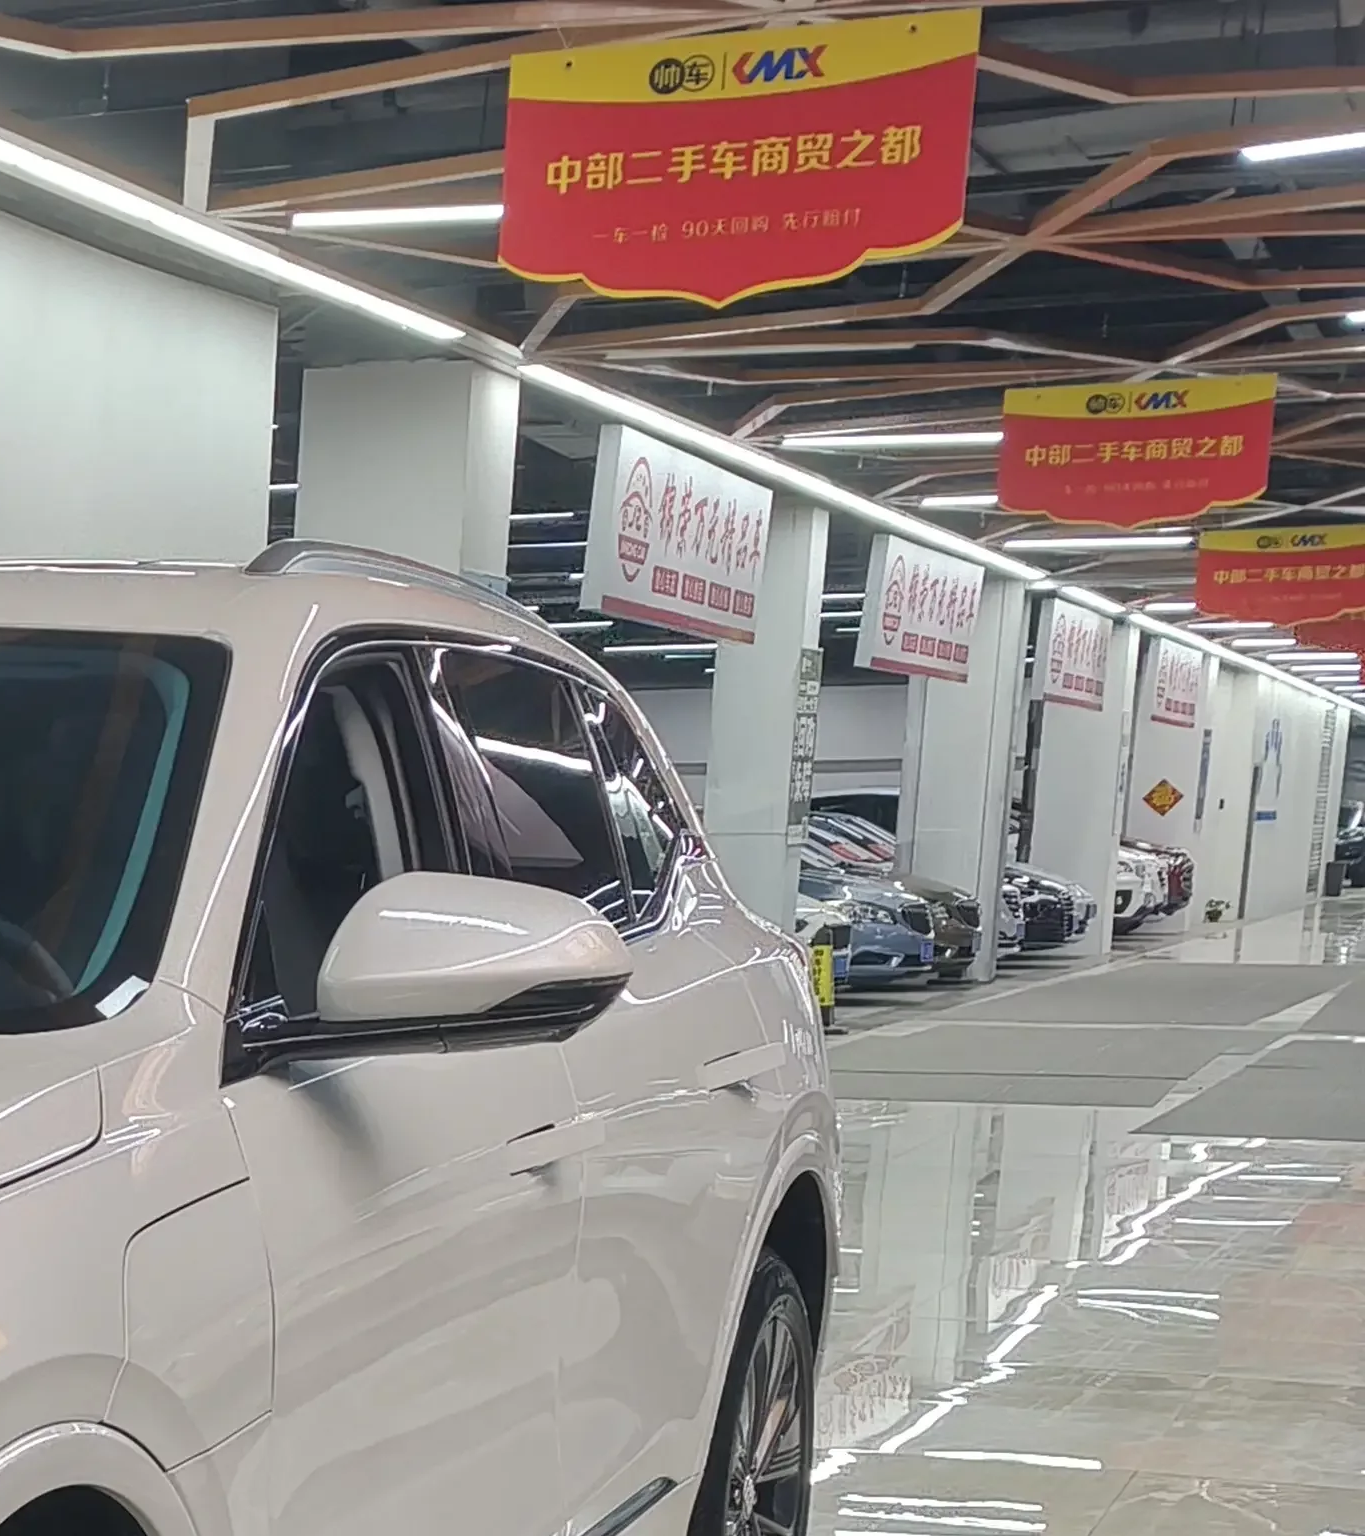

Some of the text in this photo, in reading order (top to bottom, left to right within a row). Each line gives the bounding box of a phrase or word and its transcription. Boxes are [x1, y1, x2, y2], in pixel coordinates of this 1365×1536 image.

[546, 125, 922, 194] 中部二手车商贸之都
[1025, 434, 1244, 467] 中部二手车商贸之都
